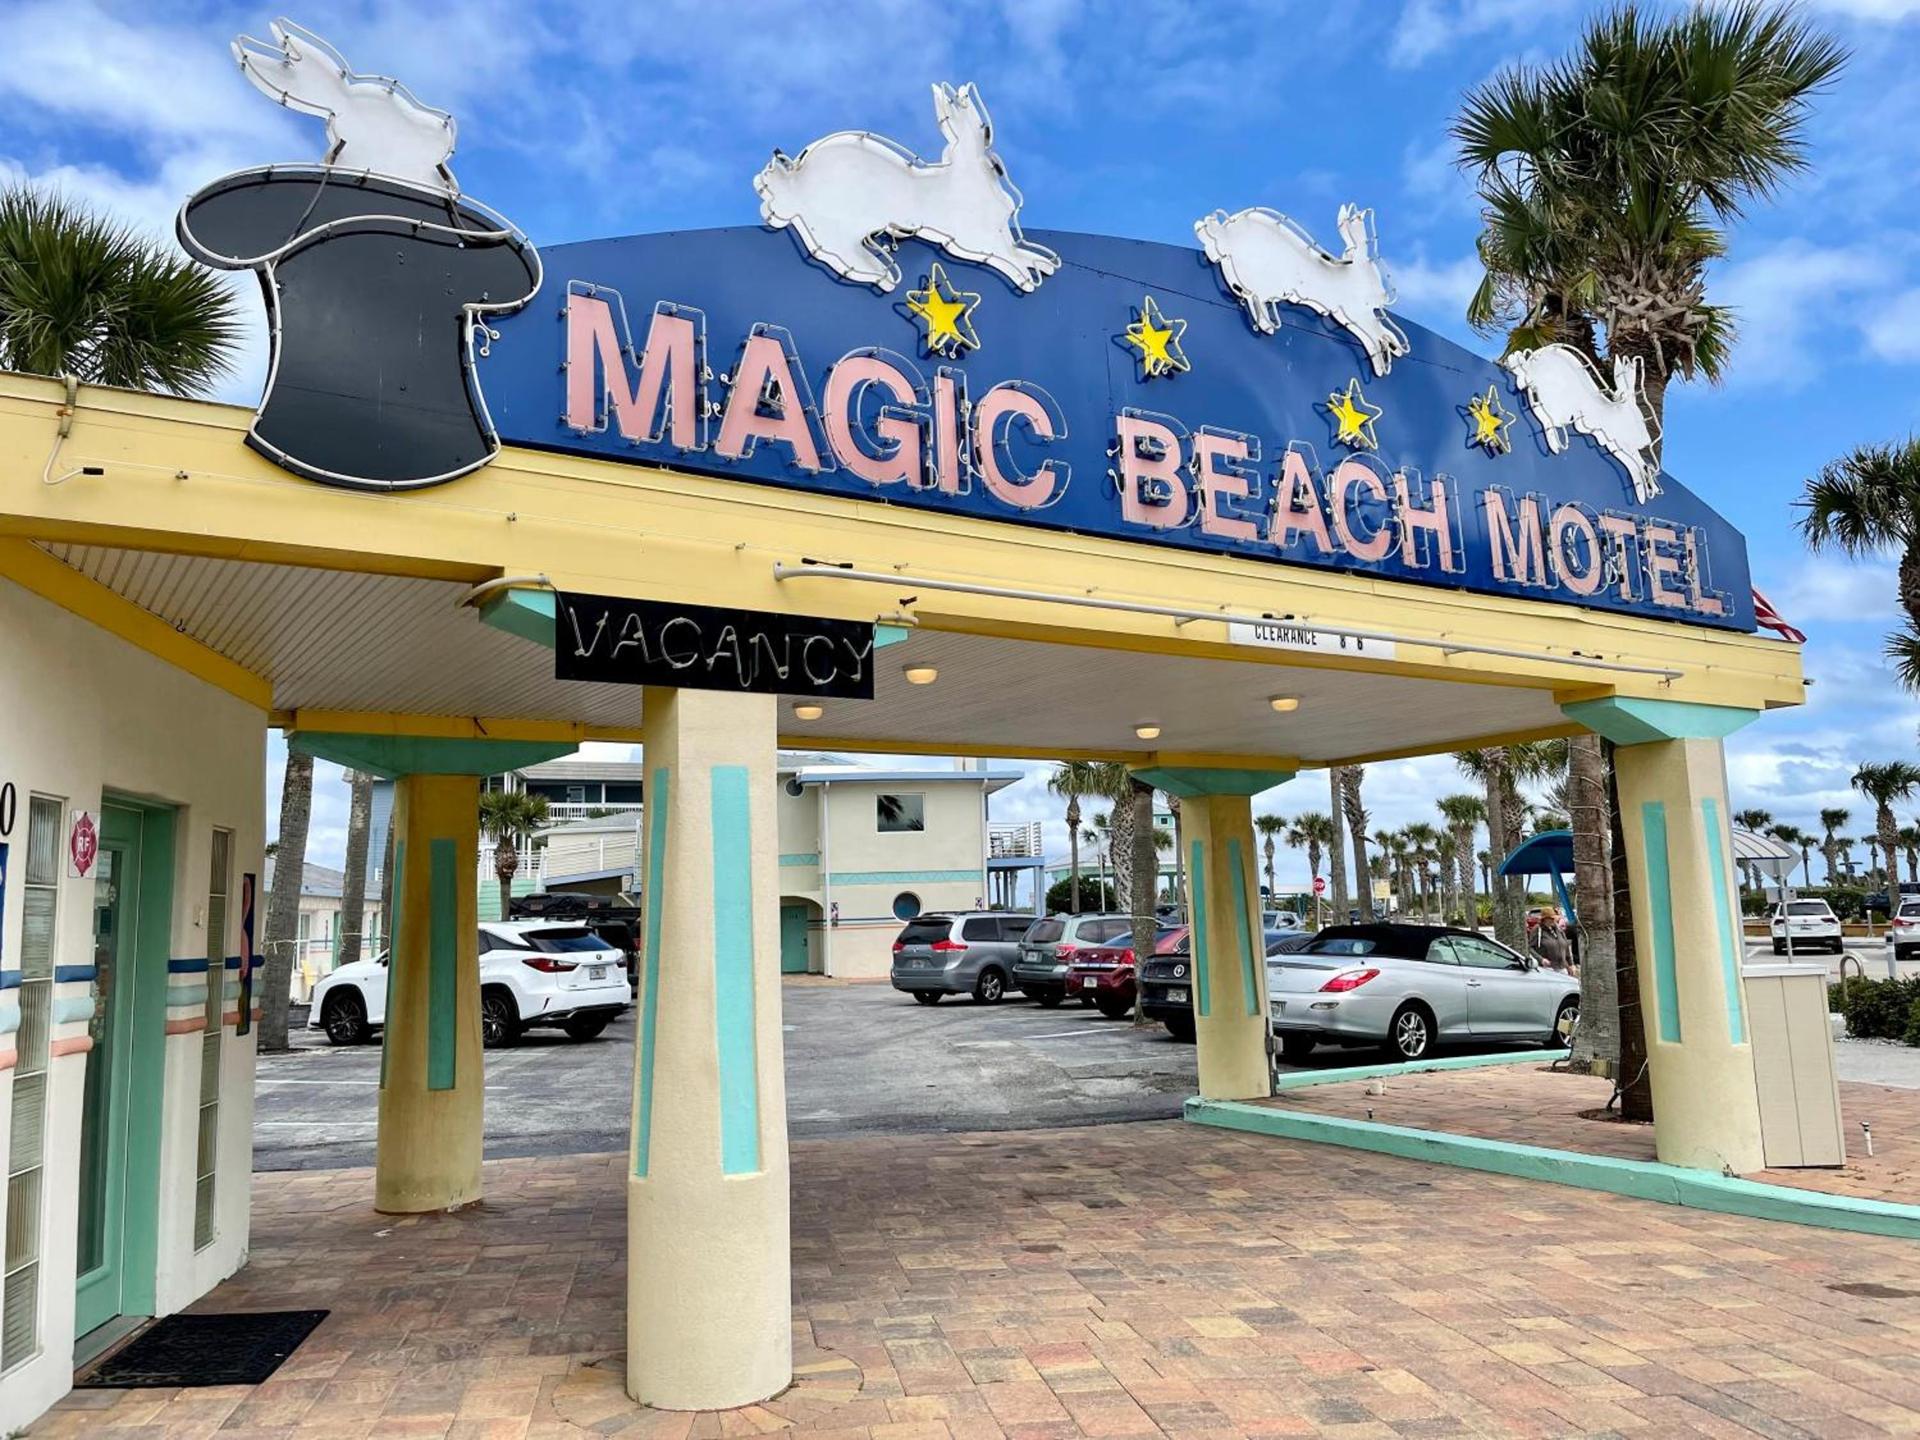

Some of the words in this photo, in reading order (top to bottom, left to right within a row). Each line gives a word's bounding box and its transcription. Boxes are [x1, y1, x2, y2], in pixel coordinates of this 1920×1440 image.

[566, 281, 1072, 510] MAGIC
[1116, 408, 1464, 573] BEACH
[1485, 484, 1735, 617] MOTEL
[568, 606, 873, 688] VACANCY
[1254, 625, 1318, 646] CLEARANCE
